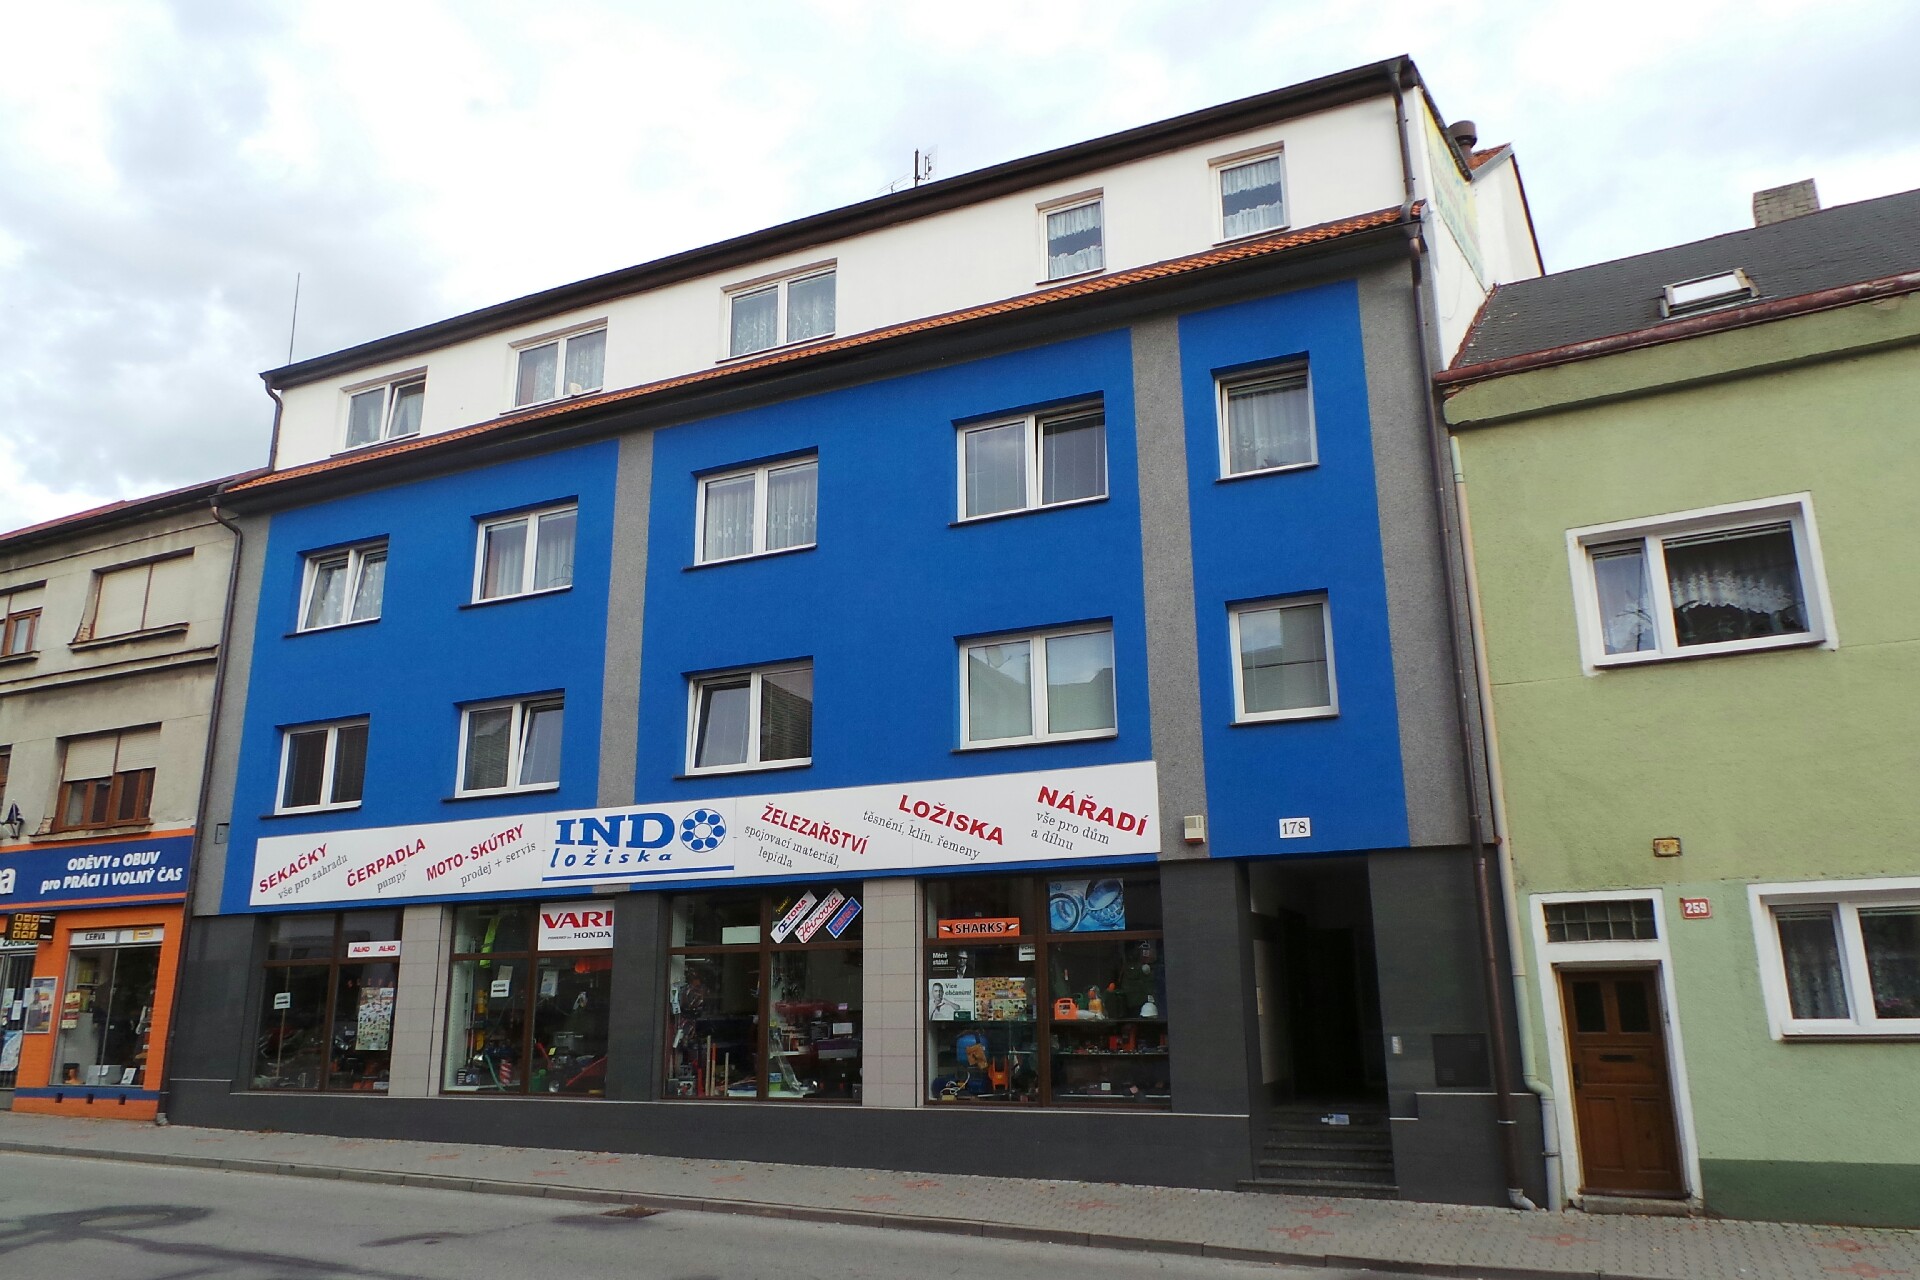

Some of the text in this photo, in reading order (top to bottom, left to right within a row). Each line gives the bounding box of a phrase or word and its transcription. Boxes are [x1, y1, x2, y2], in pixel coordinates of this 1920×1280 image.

[898, 794, 1003, 846] LOŽISKA
[1037, 786, 1149, 836] NÁŘADÍ
[760, 802, 870, 855] ŽELEZAŘSTVÍ
[863, 810, 980, 860] těsnění, klín. řemeny
[1031, 829, 1074, 851] a dílnu
[1036, 811, 1110, 845] vše pro dům
[1282, 821, 1307, 835] 178
[550, 848, 672, 868] ložiska
[744, 826, 840, 868] spojovací materiál,
[758, 846, 793, 868] lepidla
[67, 851, 161, 871] ODĚVY a OBUV
[259, 842, 327, 893] SEKAČKY
[346, 838, 426, 887] ČERPADLA
[460, 861, 492, 887] prodej
[505, 842, 536, 864] servis
[40, 879, 61, 894] pro
[63, 873, 100, 889] PRÁCI
[112, 867, 155, 886] VOLNÝ
[157, 867, 183, 882] ČAS
[278, 854, 348, 899] vše pro zahradu
[376, 869, 408, 893] pumpy
[542, 910, 613, 929] VARI
[785, 899, 807, 921] TONA
[1685, 902, 1708, 914] 259
[573, 931, 611, 939] HONDA
[955, 922, 1003, 934] SHARKS
